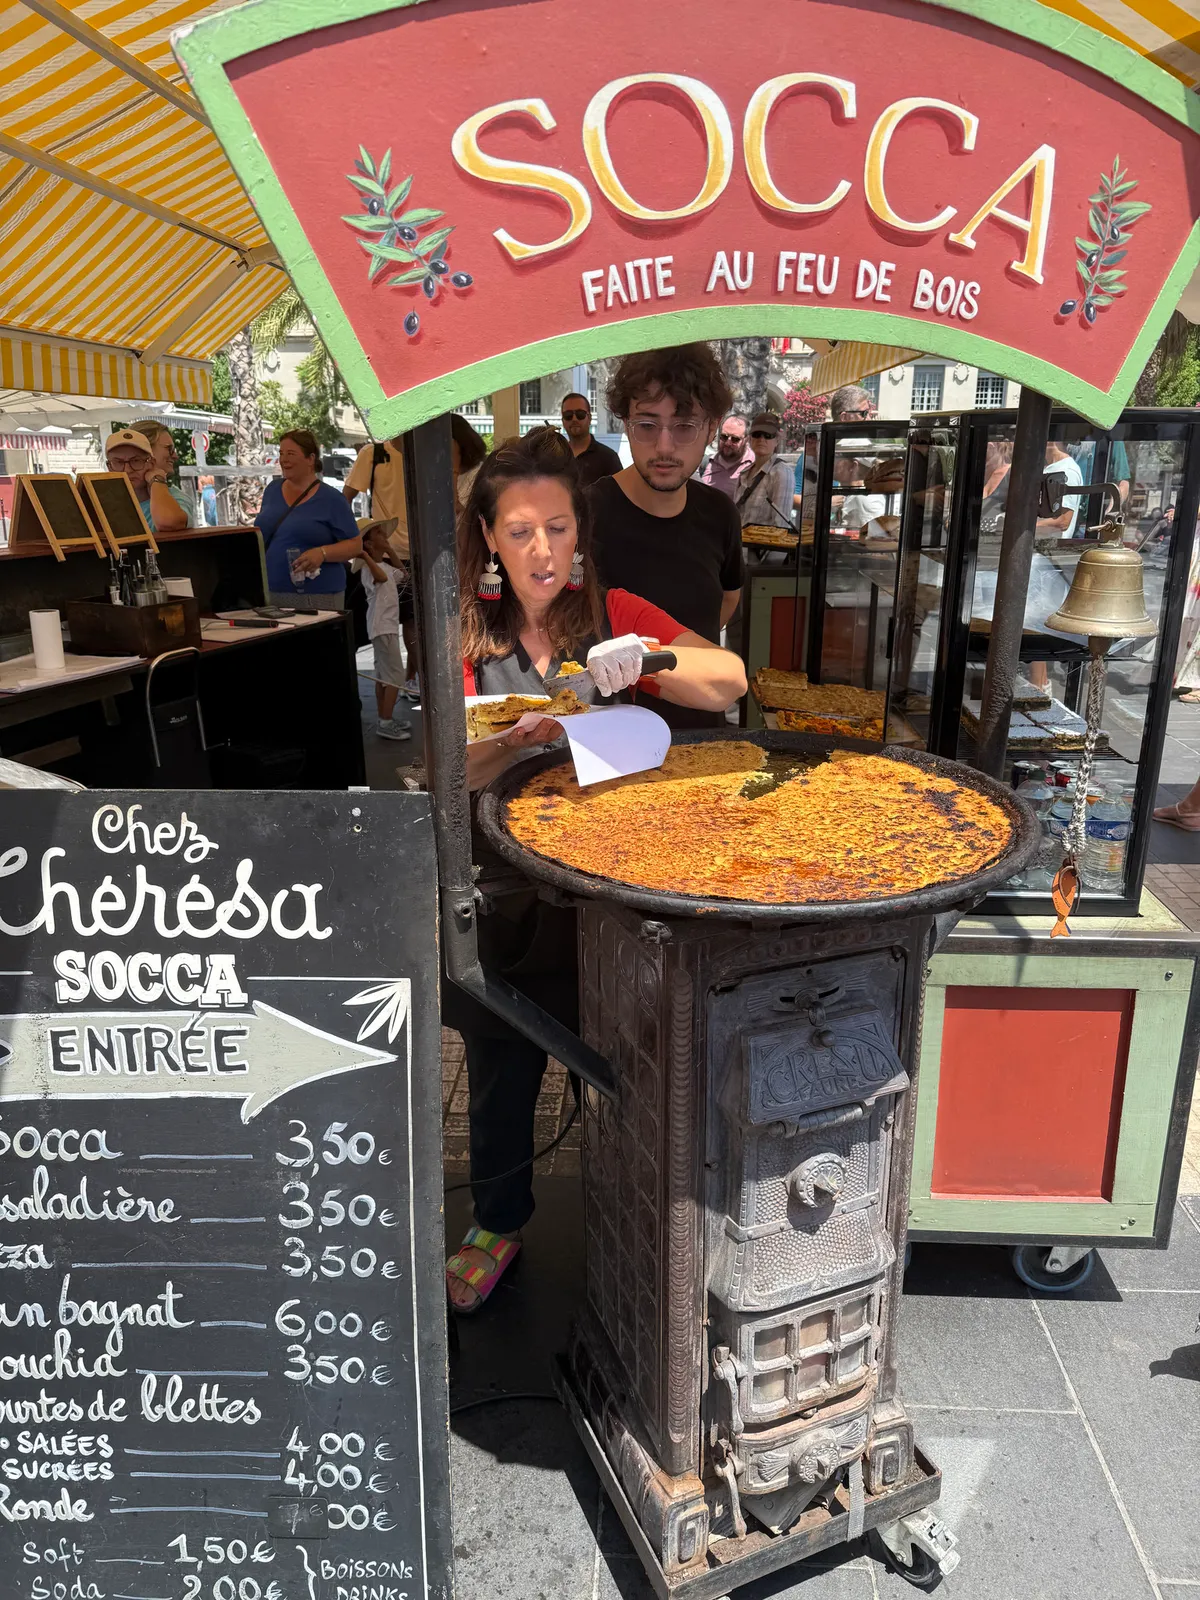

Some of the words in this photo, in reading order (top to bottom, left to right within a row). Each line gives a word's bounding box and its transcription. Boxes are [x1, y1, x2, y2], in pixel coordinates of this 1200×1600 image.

[451, 72, 1056, 284] SOCCA
[581, 255, 676, 313] FAITE
[706, 250, 755, 293] AU
[777, 250, 840, 296] FEU
[855, 258, 896, 303] DE
[912, 268, 982, 320] BOIS
[91, 803, 220, 864] Chez
[53, 949, 249, 1009] SOCCA
[48, 1012, 251, 1076] ENTRÉE
[275, 1119, 393, 1178] 3,50€
[0, 1164, 182, 1223] saladière
[278, 1180, 400, 1234] 3,50€
[281, 1236, 402, 1284] 3,50€
[59, 1273, 195, 1357] bagnat
[88, 1388, 128, 1422] de
[140, 1372, 263, 1425] blettes
[1, 1458, 115, 1482] SUCRÉES
[16, 1429, 114, 1459] SALÉES
[22, 1537, 85, 1573] Soft
[166, 1533, 277, 1573] 1,50€
[30, 1575, 106, 1600] Soda
